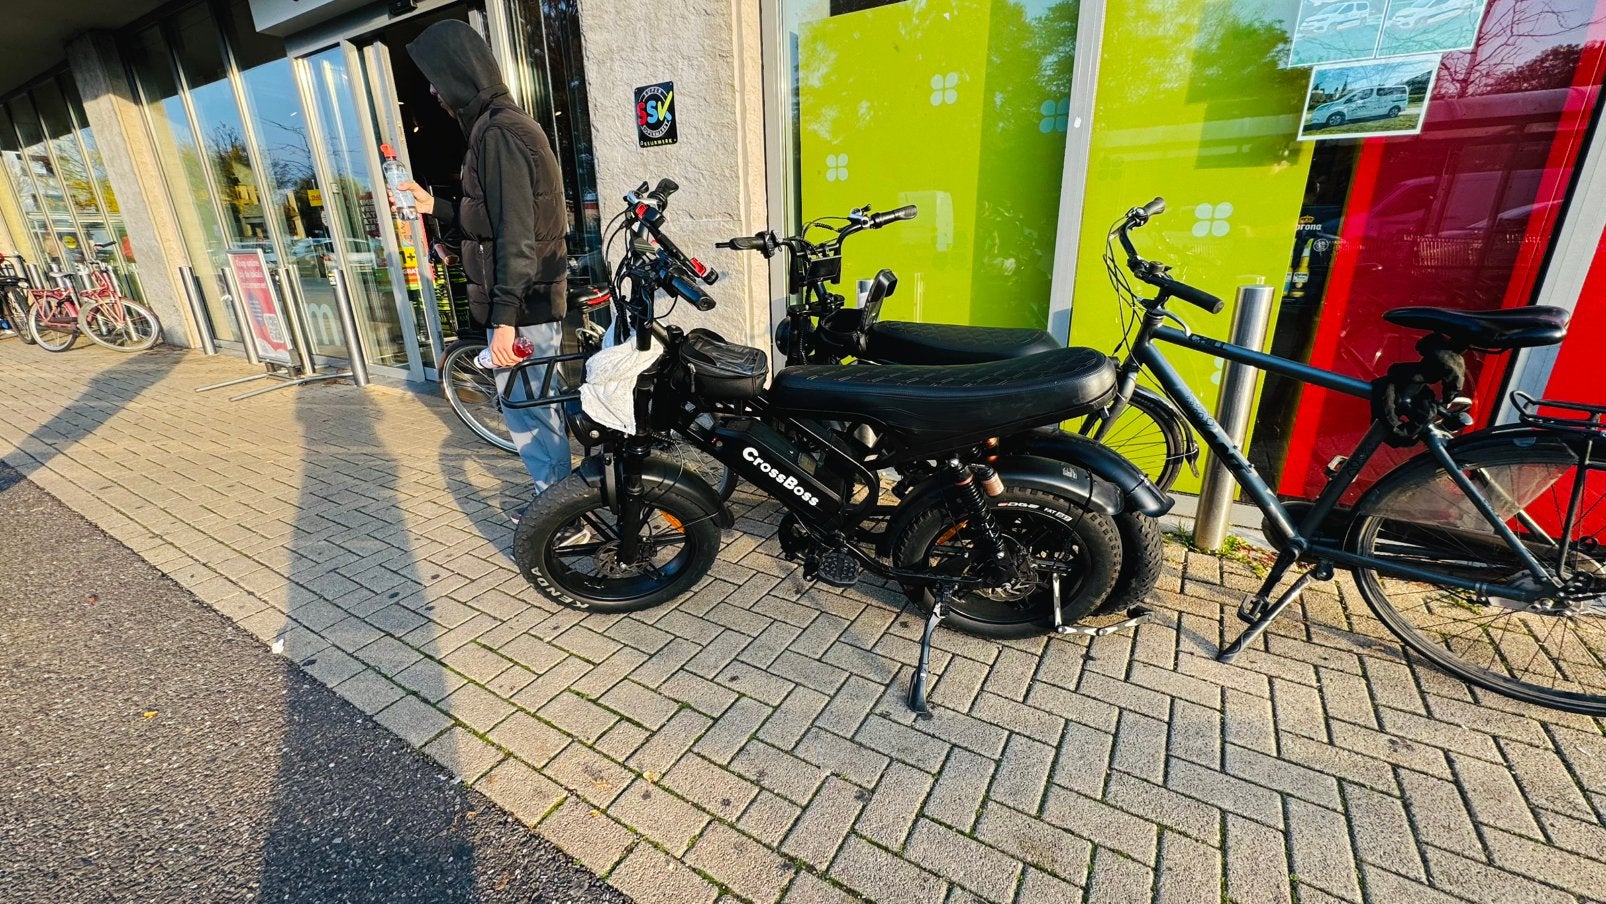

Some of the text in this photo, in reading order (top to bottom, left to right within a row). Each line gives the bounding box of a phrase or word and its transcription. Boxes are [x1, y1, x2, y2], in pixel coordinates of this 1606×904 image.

[1296, 223, 1322, 231] orona
[743, 447, 819, 506] CrossBoss
[531, 567, 589, 608] KENDA
